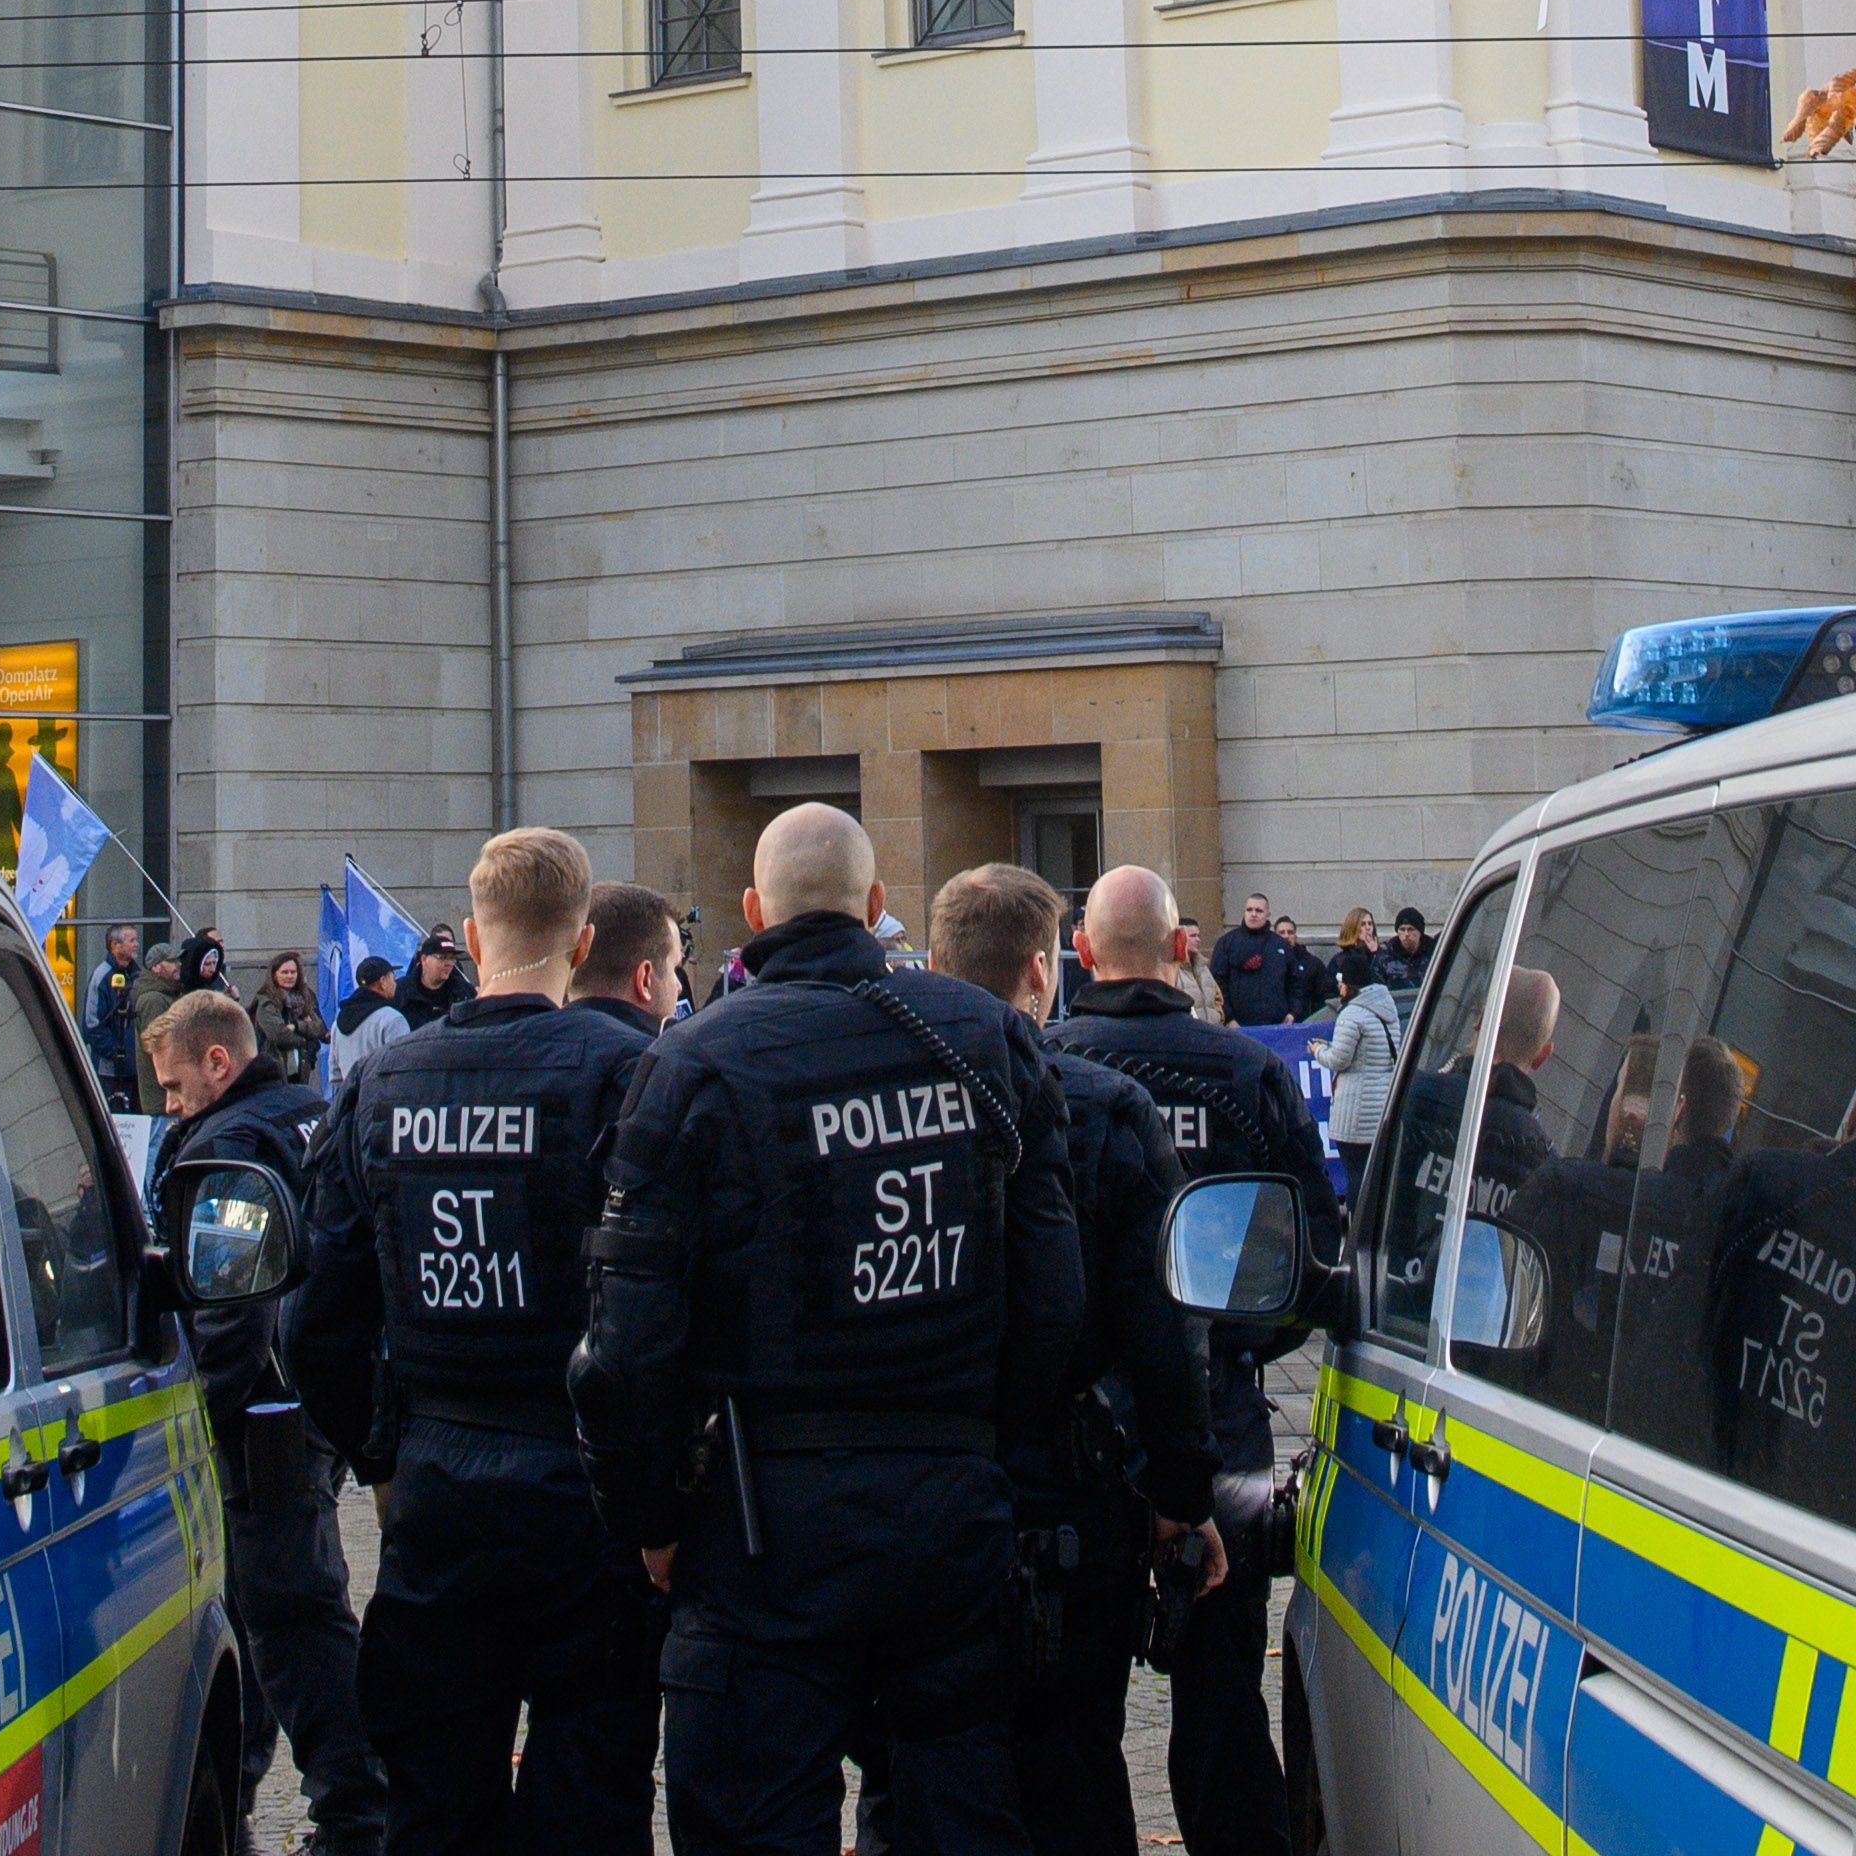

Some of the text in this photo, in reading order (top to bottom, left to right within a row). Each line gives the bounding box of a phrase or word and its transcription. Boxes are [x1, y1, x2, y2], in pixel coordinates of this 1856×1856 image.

[392, 1106, 534, 1153] POLIZEI
[812, 1082, 976, 1156] POLIZEI
[432, 1189, 493, 1247] ST
[875, 1161, 943, 1233] ST
[420, 1250, 524, 1308] 52311
[853, 1224, 965, 1304] 52217
[1430, 1551, 1550, 1785] POLIZEI
